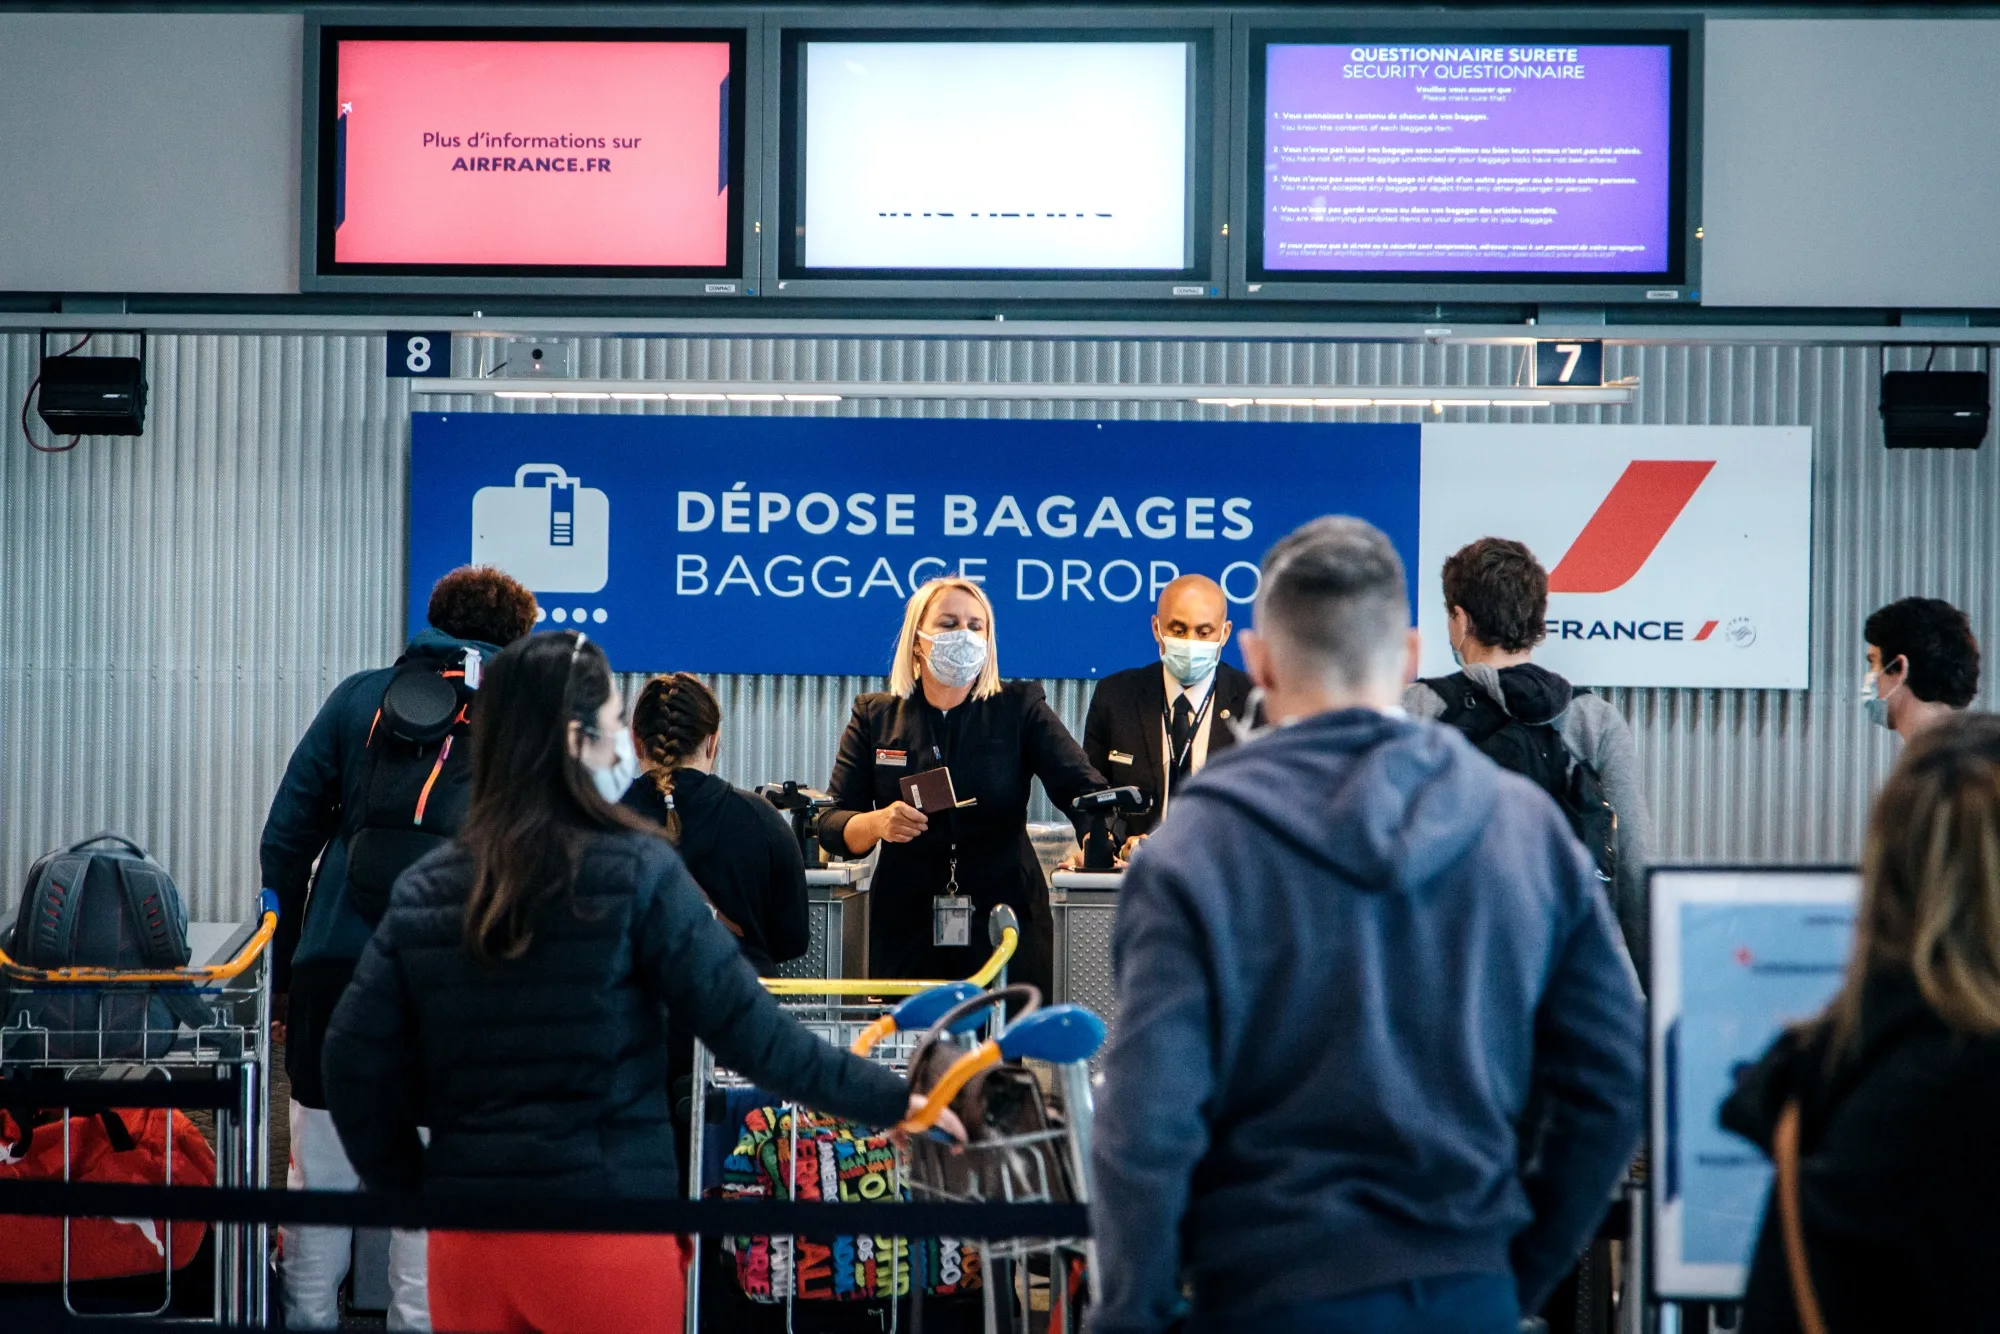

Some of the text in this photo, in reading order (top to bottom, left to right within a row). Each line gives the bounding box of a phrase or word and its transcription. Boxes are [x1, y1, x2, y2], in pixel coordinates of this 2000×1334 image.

[1350, 47, 1578, 63] QUESTIONNAIRE SURETE
[1342, 63, 1586, 80] SECURITY QUESTIONNAIRE
[423, 131, 642, 149] Plus d'informations sur
[451, 157, 612, 172] AIRFRANCE.FR
[406, 336, 432, 373] 8
[1554, 343, 1583, 383] 7
[676, 481, 1254, 541] DÉPOSE BAGAGES
